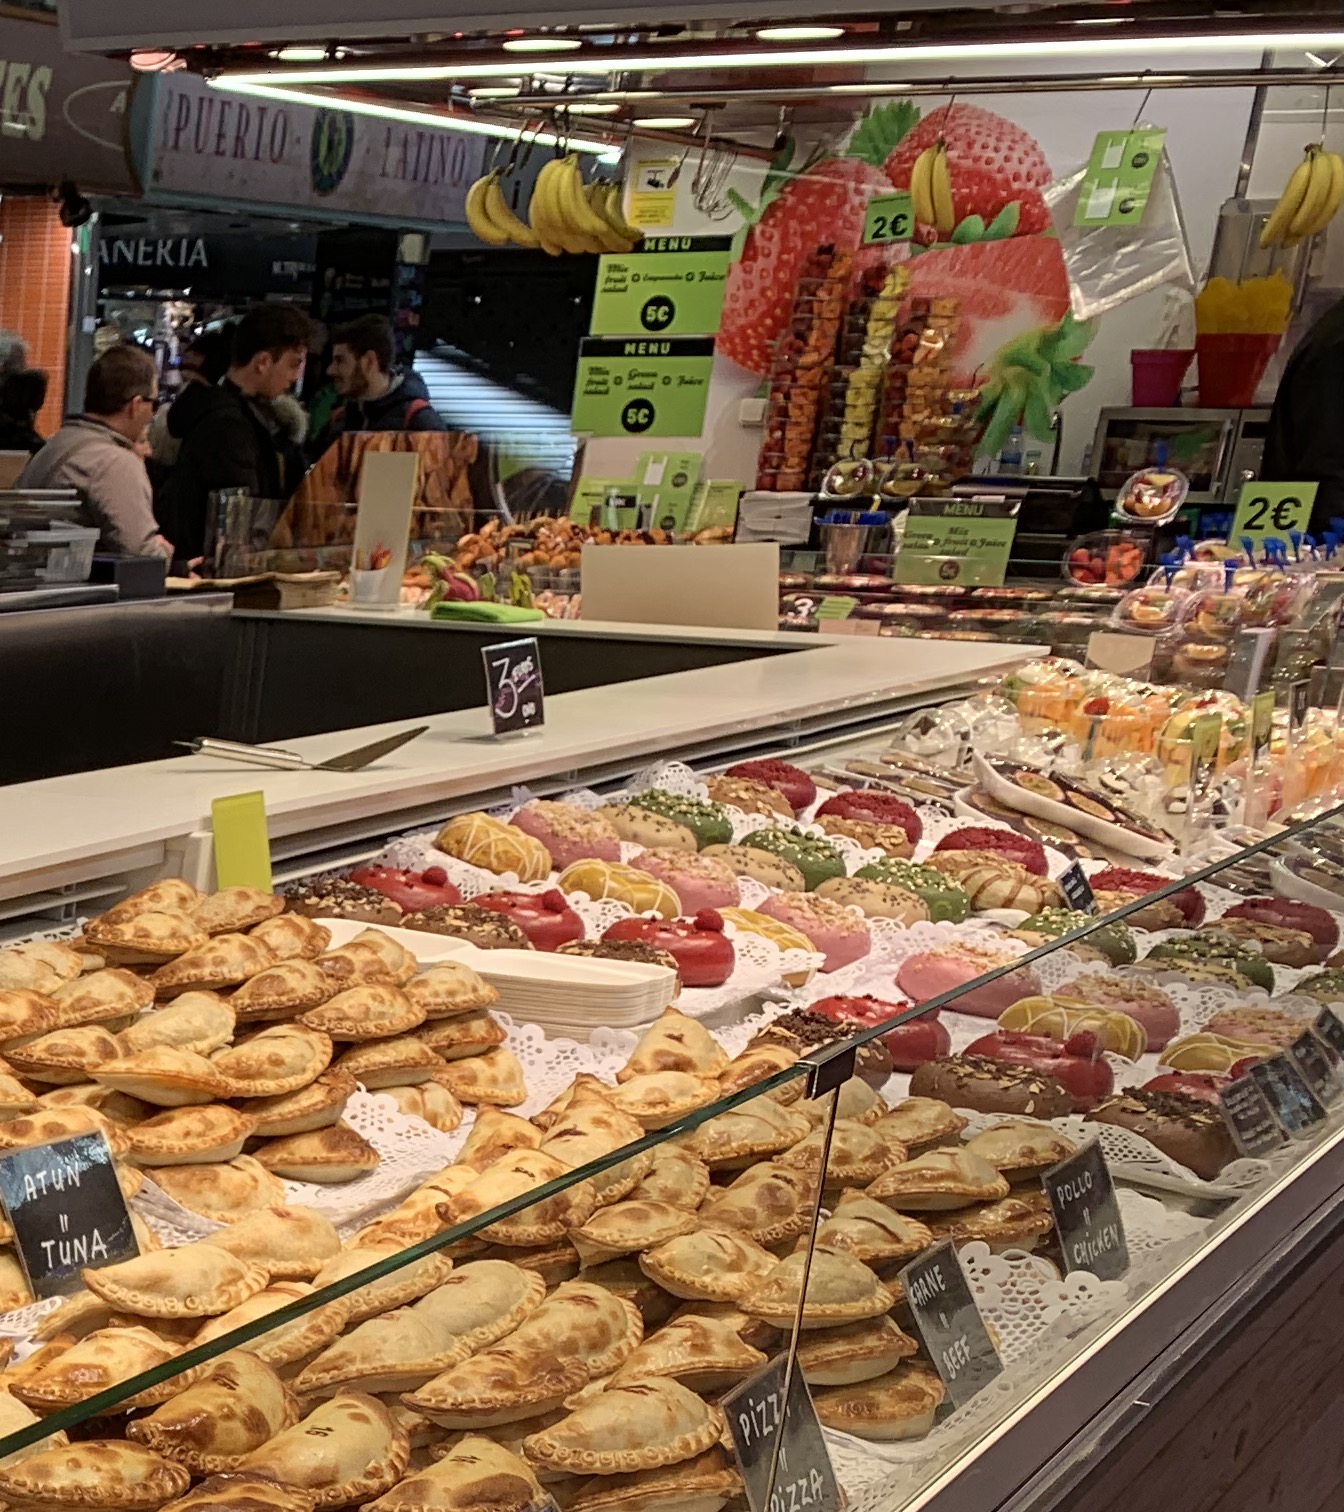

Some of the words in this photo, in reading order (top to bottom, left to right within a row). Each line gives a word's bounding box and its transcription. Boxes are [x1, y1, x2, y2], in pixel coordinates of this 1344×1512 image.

[171, 92, 288, 163] PUERTO
[379, 126, 468, 187] LATINO
[644, 237, 692, 250] MENU
[871, 213, 909, 239] 2€
[624, 342, 671, 355] MENU
[943, 503, 984, 516] MENU
[1243, 496, 1302, 530] 2€
[23, 1161, 81, 1201] ATUN
[1056, 1170, 1093, 1209] POLLO
[40, 1228, 108, 1269] TUNA
[910, 1264, 946, 1307] CARNE
[942, 1334, 971, 1380] BEEF
